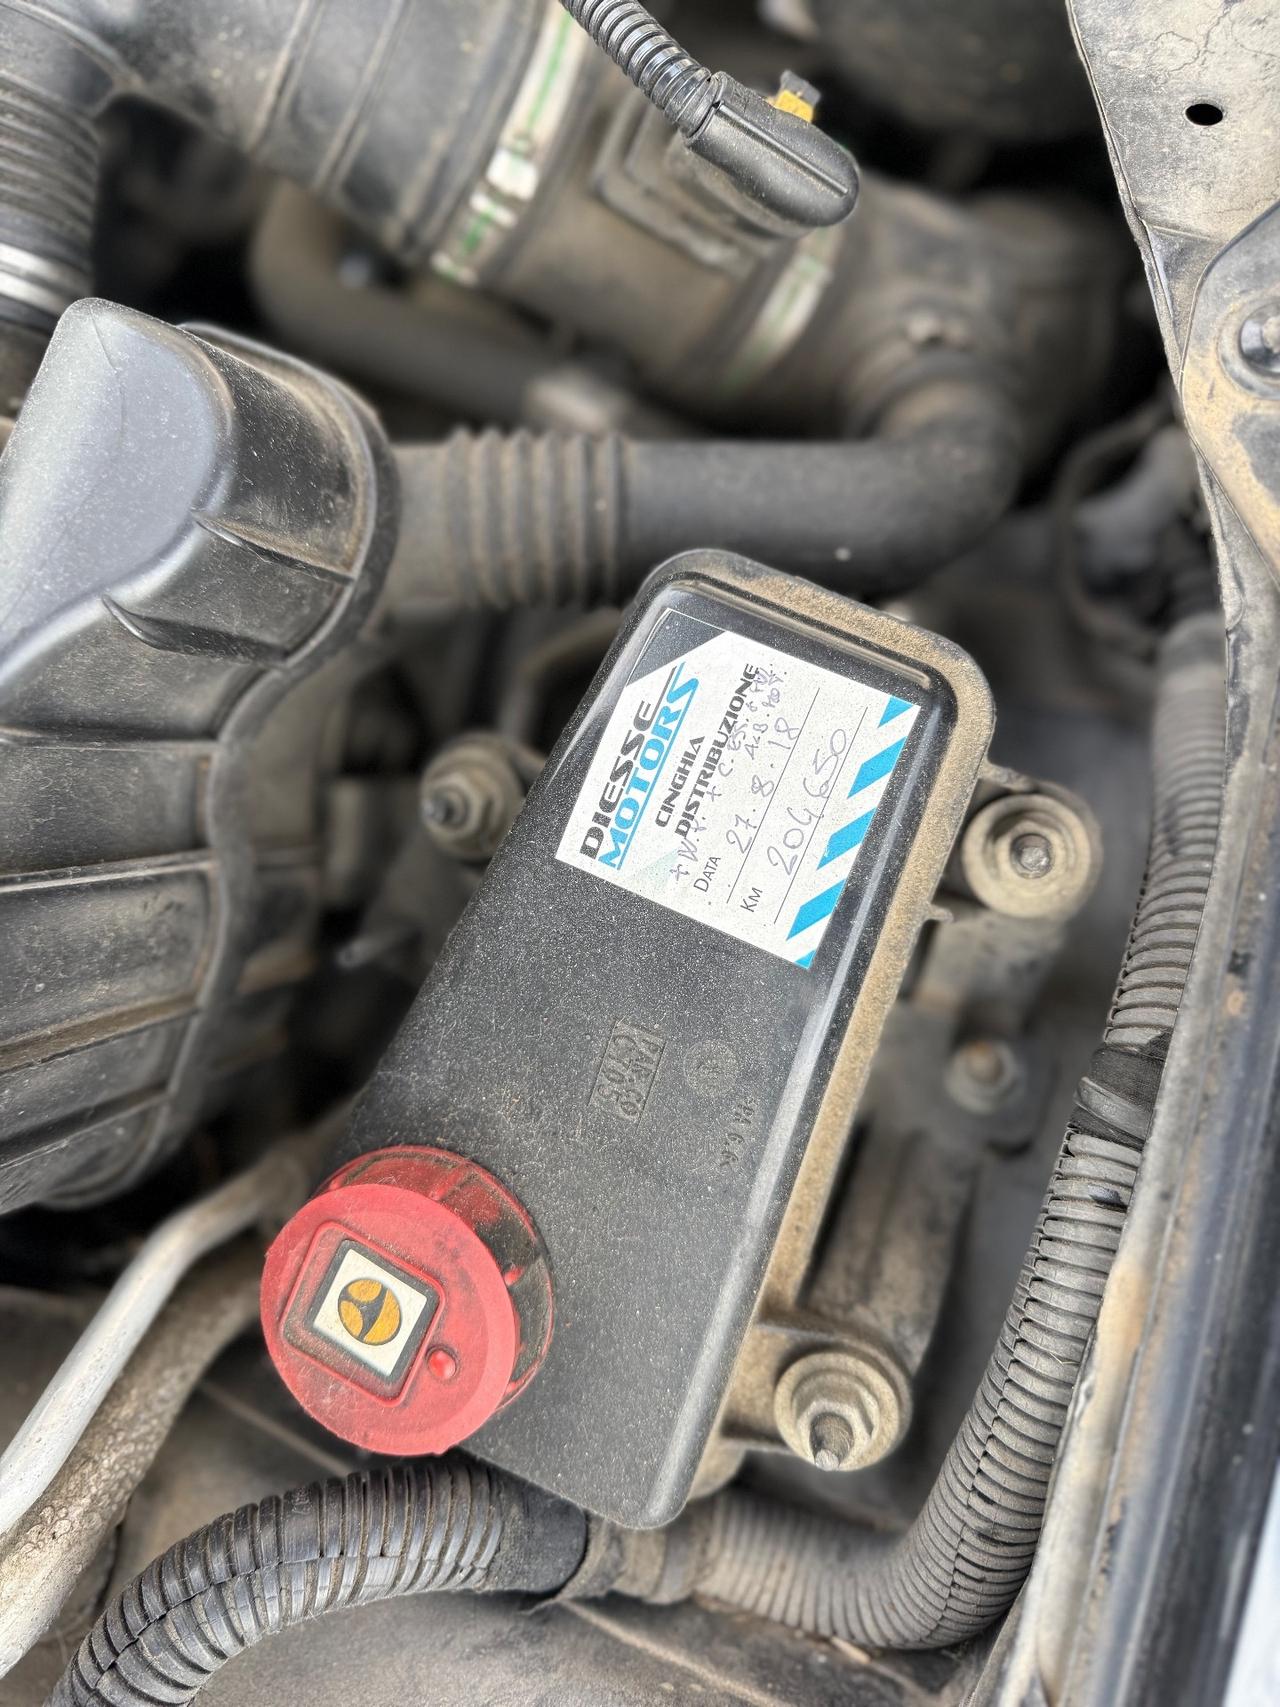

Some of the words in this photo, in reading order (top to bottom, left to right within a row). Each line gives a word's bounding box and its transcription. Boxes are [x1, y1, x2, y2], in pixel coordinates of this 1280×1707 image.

[580, 668, 675, 860] DIESSE
[598, 662, 699, 870] MOTORS
[655, 736, 706, 828] CINGHIA
[675, 663, 759, 838] DISTRIBUZIONE
[767, 728, 847, 876] 204650
[693, 856, 721, 892] DATA
[740, 887, 763, 913] KM
